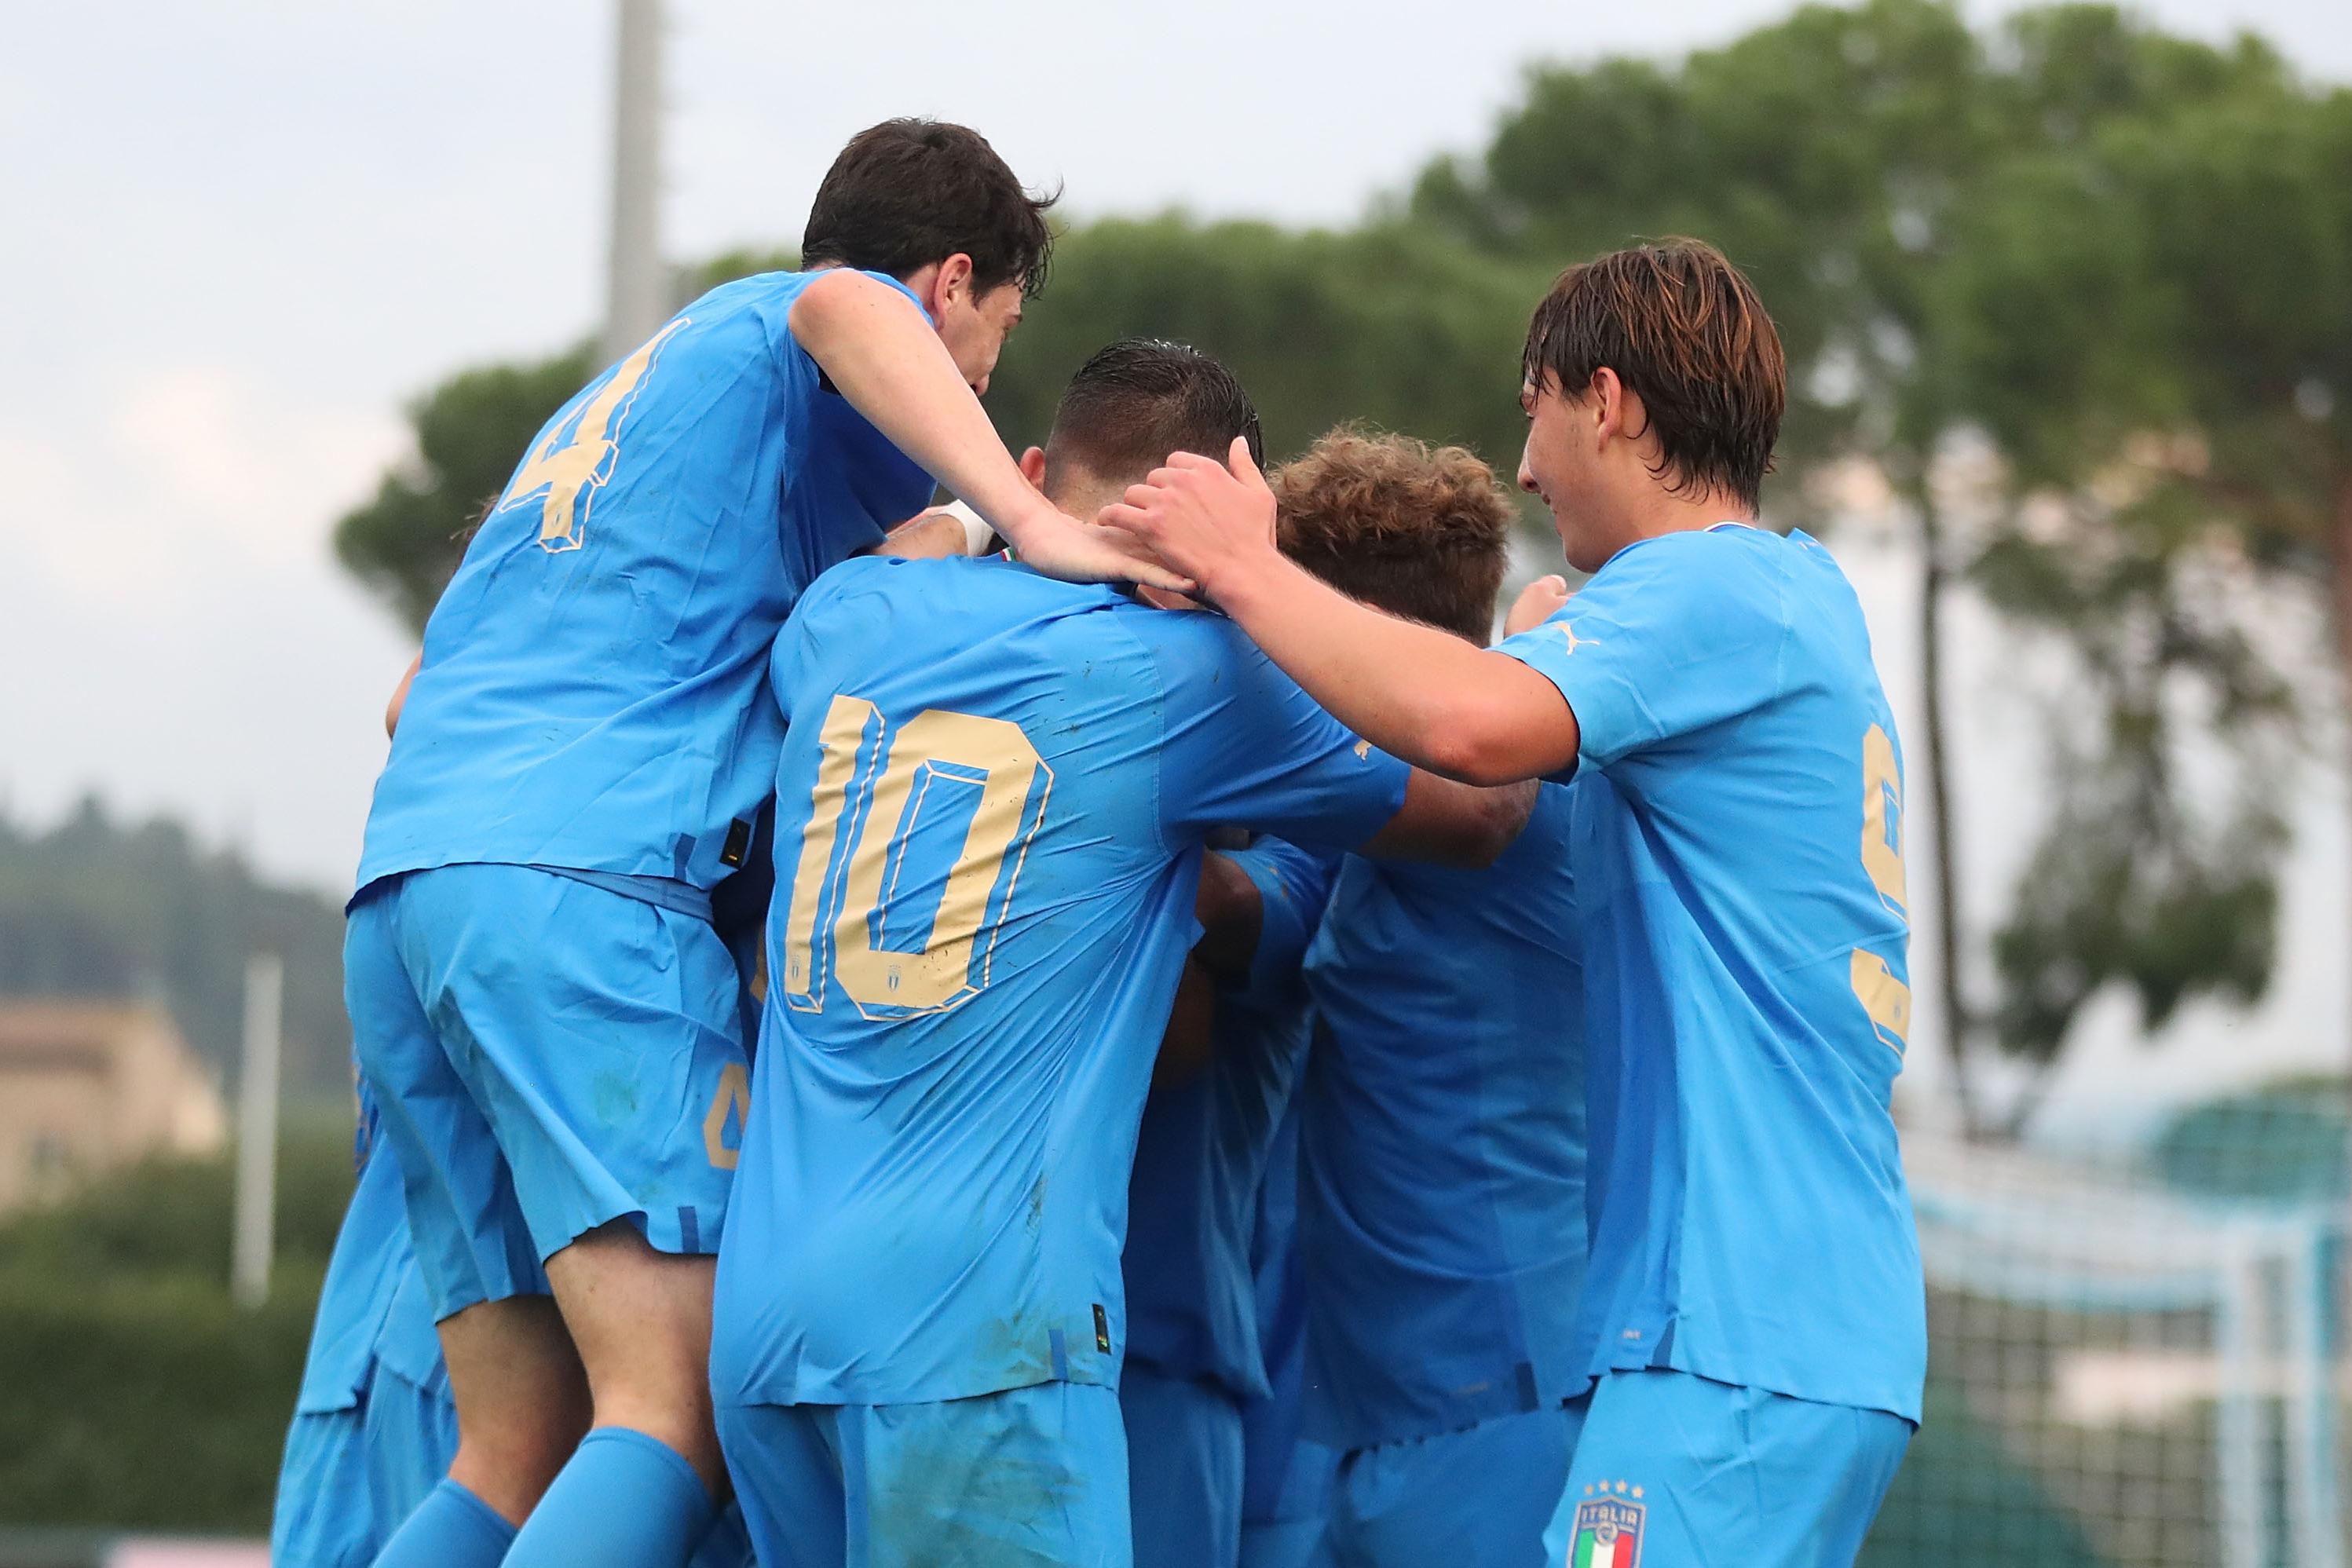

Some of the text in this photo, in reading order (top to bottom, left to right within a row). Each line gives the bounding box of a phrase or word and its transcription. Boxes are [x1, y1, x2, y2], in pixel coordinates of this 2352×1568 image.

[498, 317, 691, 554] 4
[785, 694, 1055, 1021] 10
[1850, 722, 1911, 1056] 9
[1581, 1504, 1638, 1527] ITALIA
